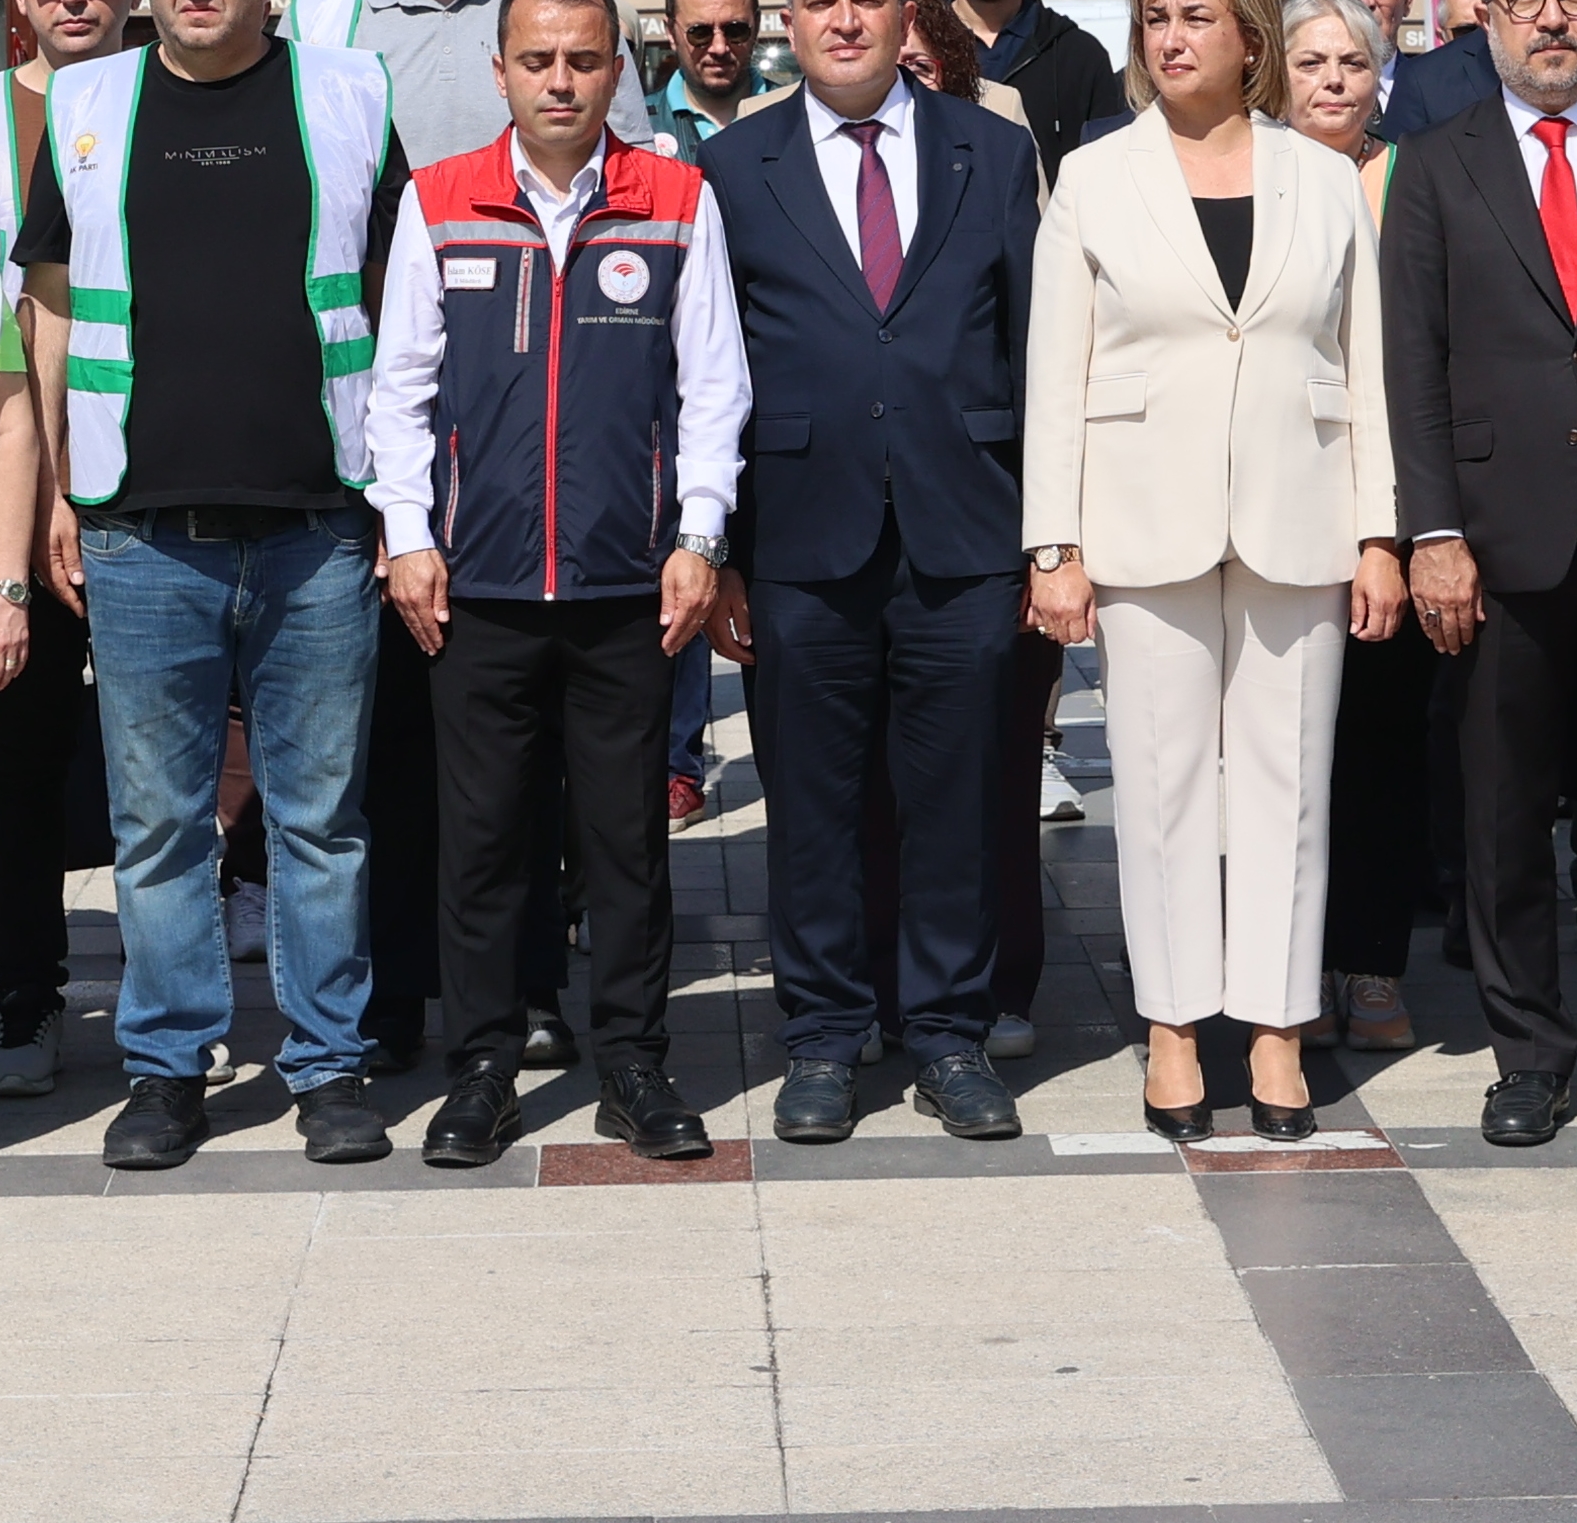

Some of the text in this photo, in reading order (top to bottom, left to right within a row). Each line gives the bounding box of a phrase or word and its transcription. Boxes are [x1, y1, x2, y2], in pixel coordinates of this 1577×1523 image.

[164, 146, 267, 160] MINIMALISM
[467, 264, 493, 276] KÖSE
[598, 316, 607, 325] VE
[608, 316, 634, 325] ORMAN
